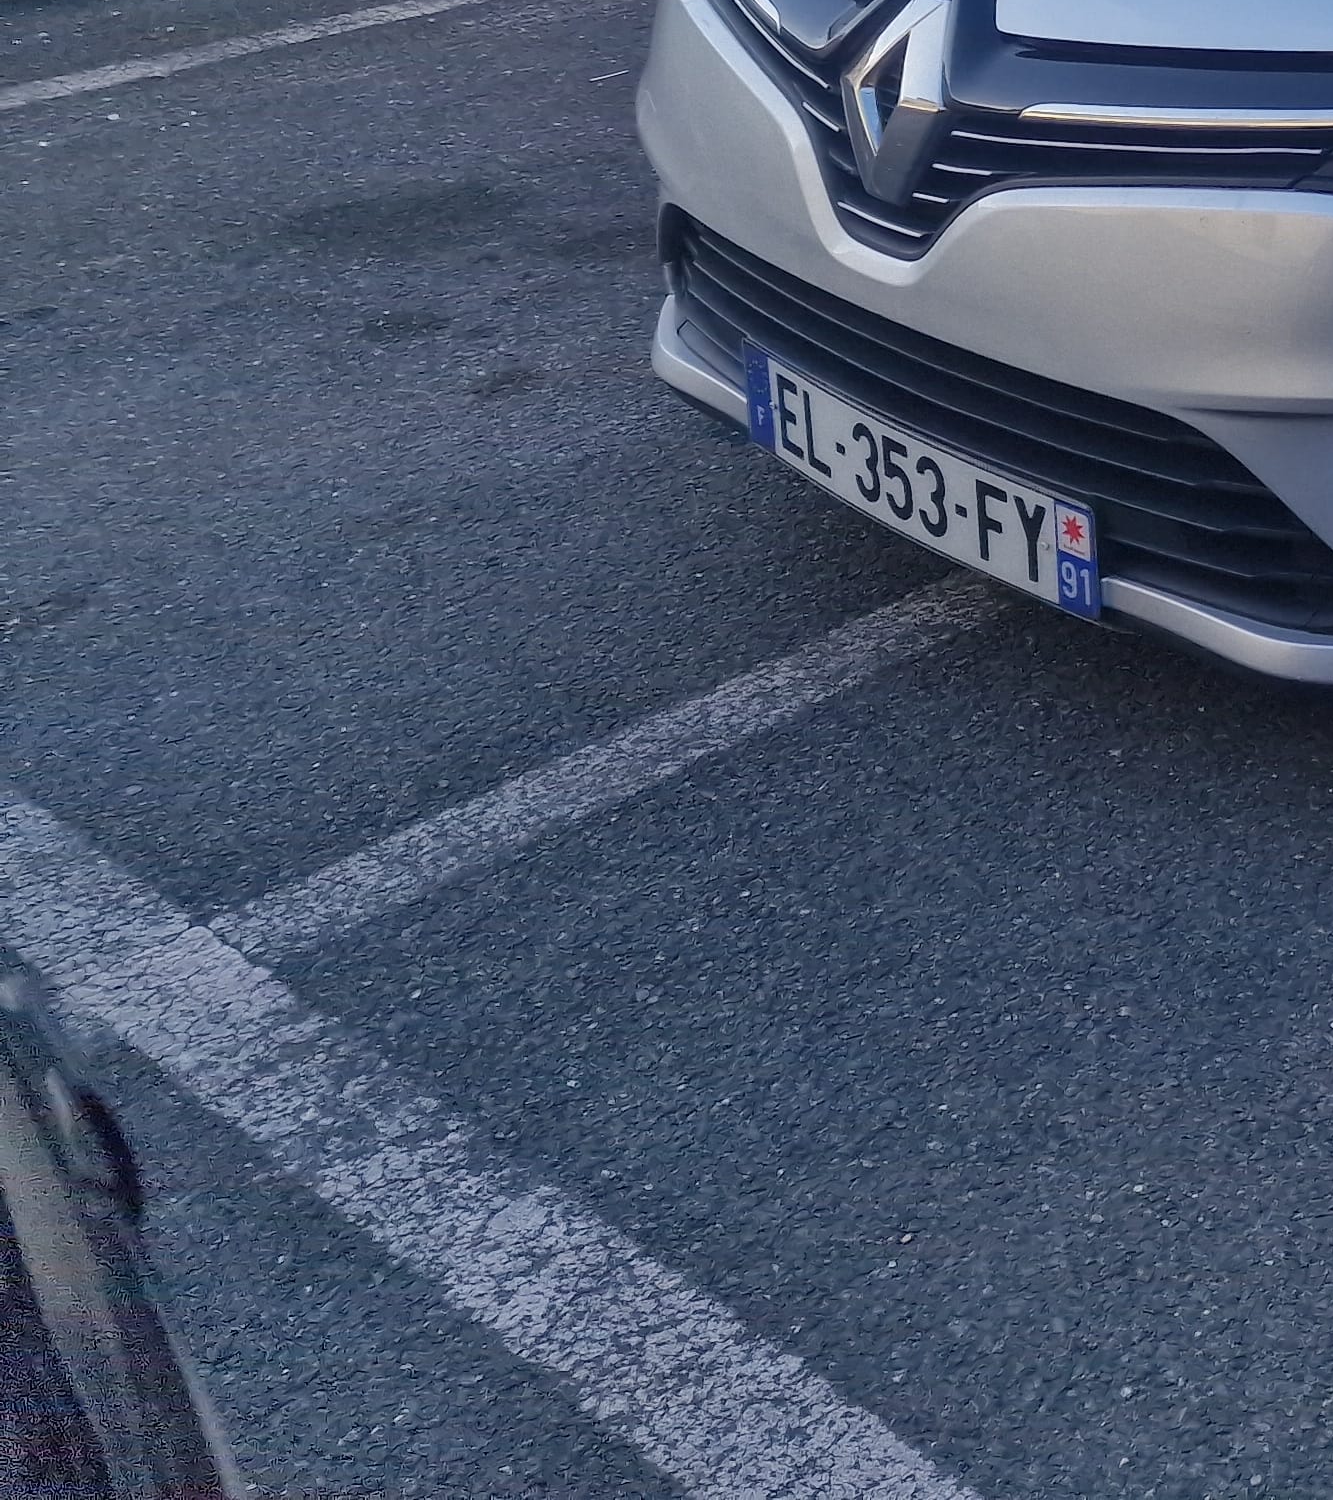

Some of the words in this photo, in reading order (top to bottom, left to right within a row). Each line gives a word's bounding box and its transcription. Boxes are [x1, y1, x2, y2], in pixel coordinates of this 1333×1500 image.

[757, 404, 765, 426] F
[776, 373, 1046, 583] EL-353-FY
[1061, 561, 1091, 606] 91
